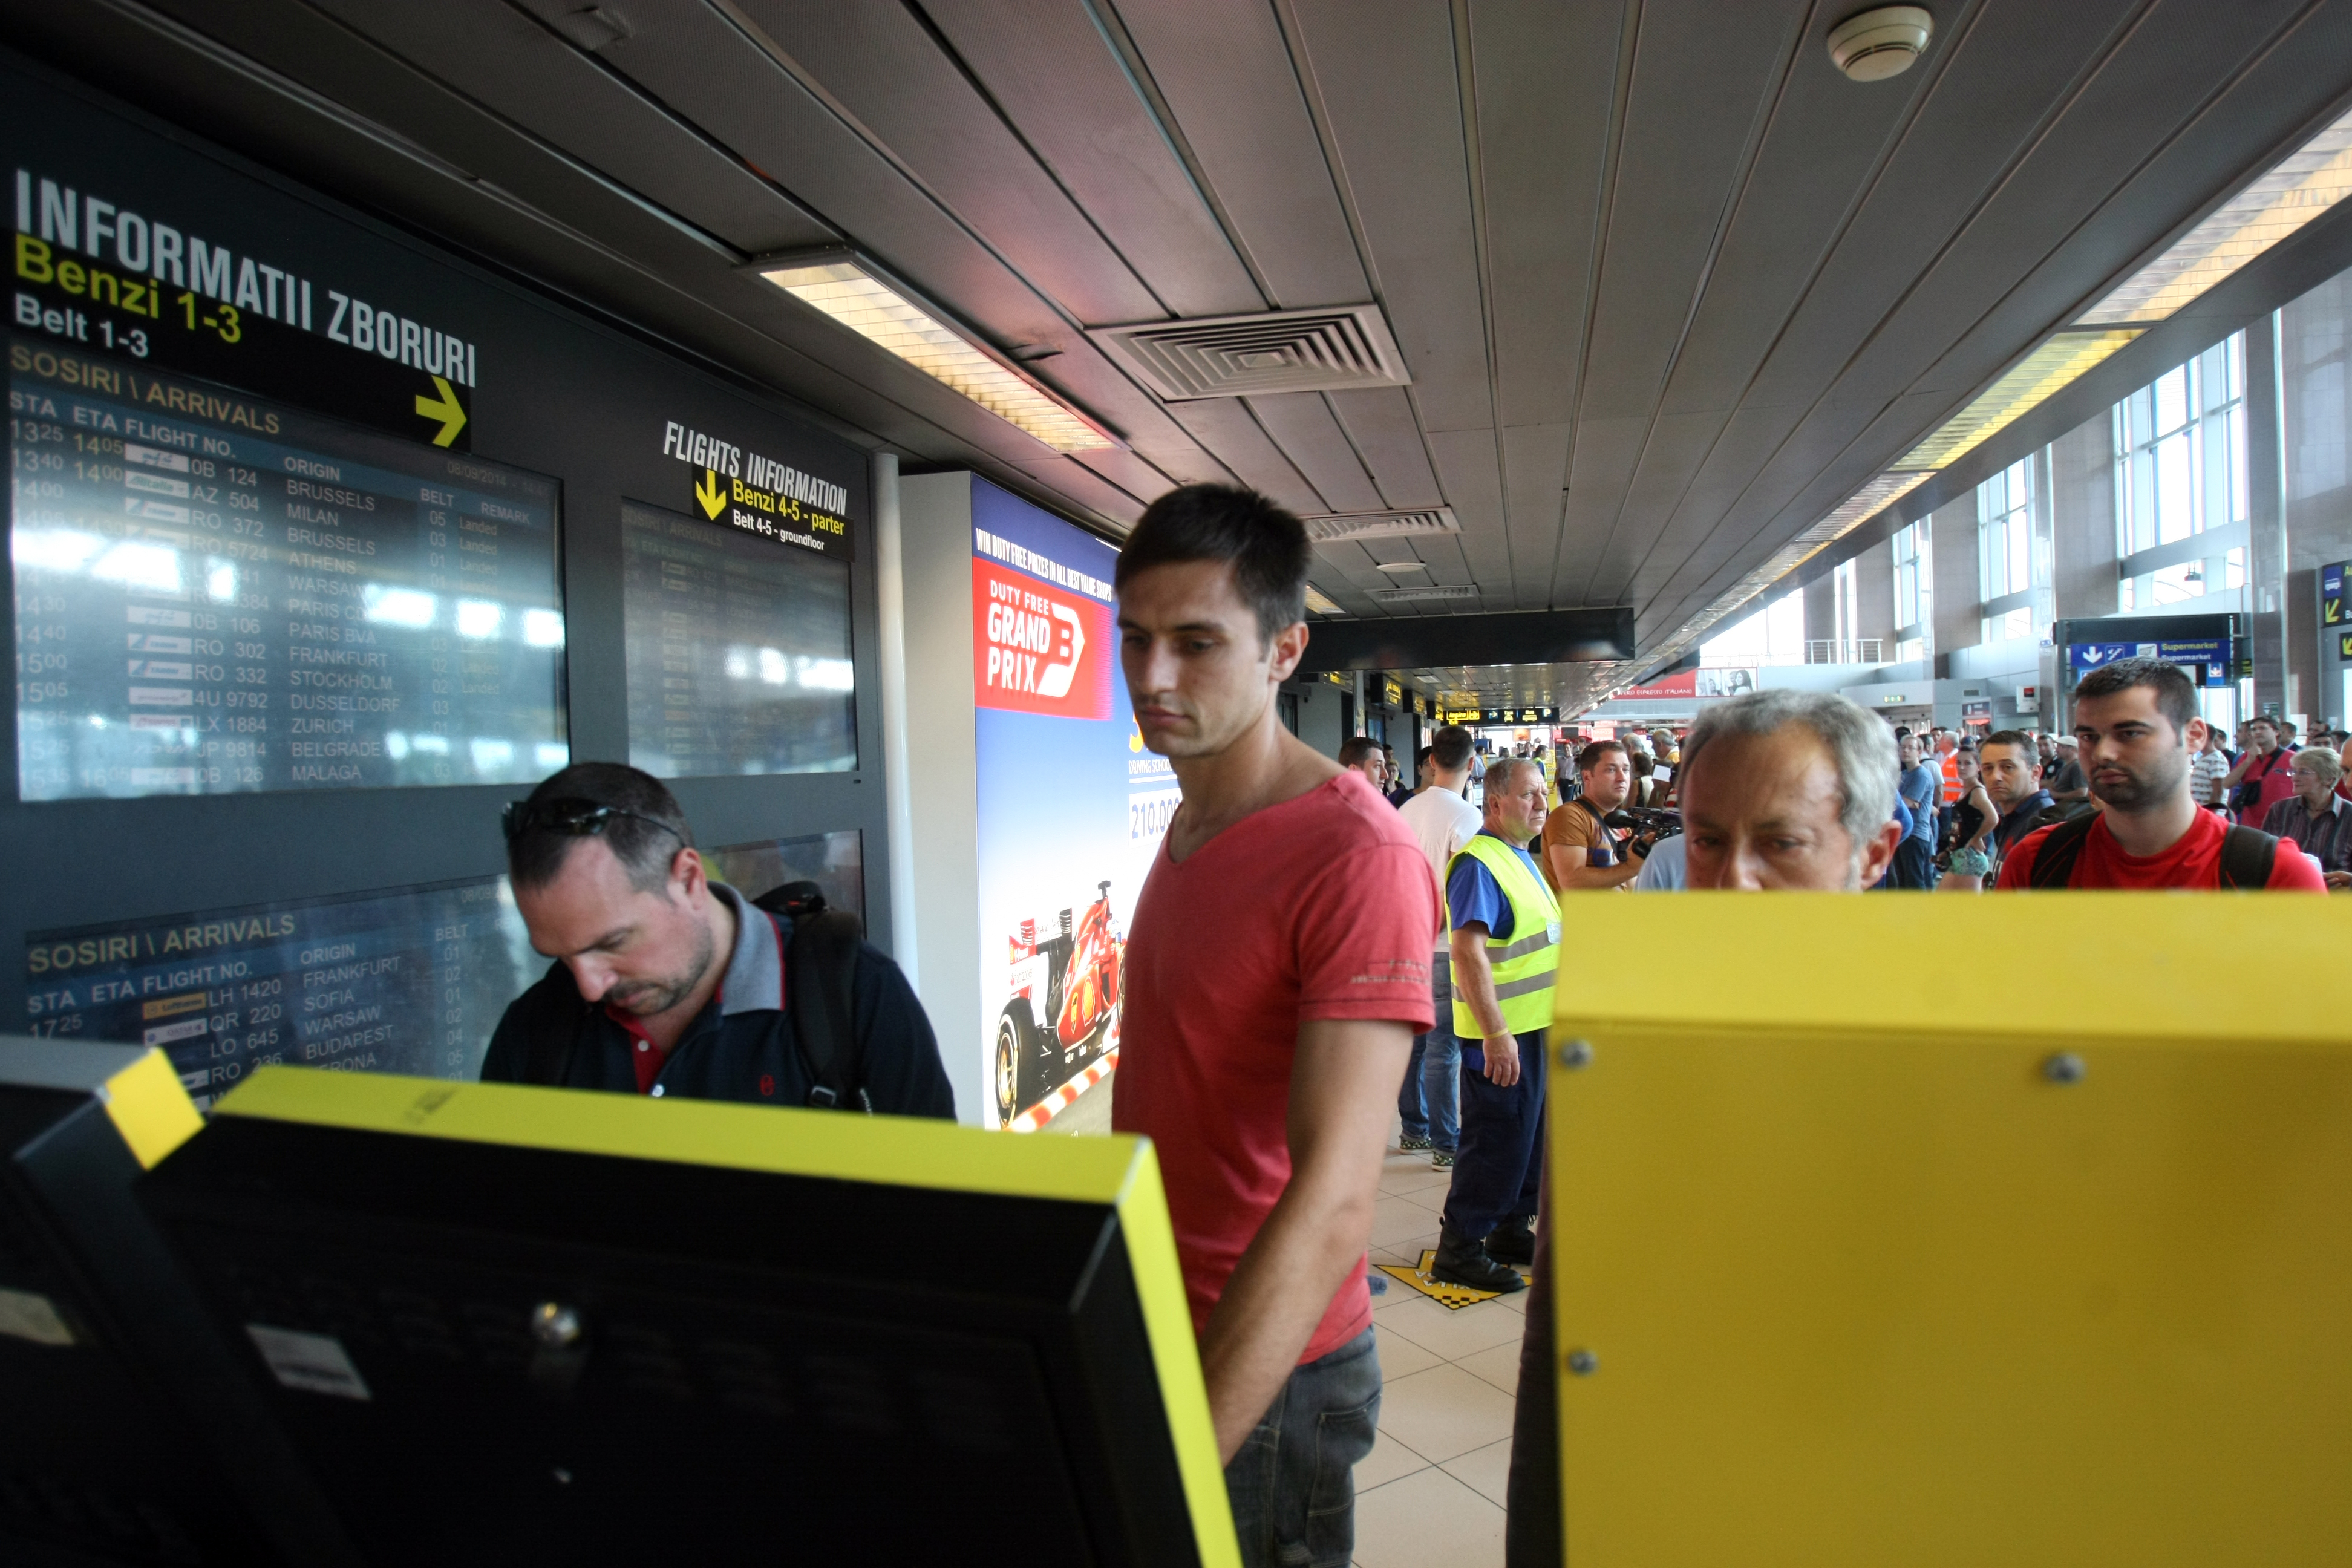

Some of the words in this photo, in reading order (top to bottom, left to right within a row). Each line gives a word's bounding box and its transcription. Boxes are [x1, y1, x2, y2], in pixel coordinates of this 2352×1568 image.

[16, 169, 312, 332] INFORMATII
[328, 290, 475, 388] ZBORURI
[16, 234, 160, 319] Benzi
[177, 292, 241, 343] 1-3
[15, 293, 87, 341] Belt
[99, 322, 149, 357] 1-3
[11, 345, 120, 395] SOSIRI
[146, 383, 280, 434] ARRIVALS
[10, 391, 57, 417] STA
[74, 406, 117, 431] ETA
[126, 419, 197, 449] FLIGHT
[204, 437, 236, 459] NO.
[284, 456, 341, 482] ORIGIN
[420, 488, 454, 508] BELT
[481, 502, 530, 525] REMARK
[664, 421, 740, 478] FLIGHTS
[747, 452, 847, 515] INFORMATION
[192, 486, 218, 505] AZ
[229, 492, 259, 511] 504
[287, 503, 338, 526] MILAN
[430, 531, 446, 547] 03
[459, 537, 497, 556] Landed
[228, 466, 257, 486] 124
[287, 480, 375, 511] BRUSSELS
[430, 510, 446, 526] 05
[459, 516, 497, 536] Landed
[733, 478, 774, 513] Benzi
[778, 498, 799, 521] 4-5
[812, 512, 844, 535] parter
[192, 511, 221, 529] RO
[234, 517, 263, 537] 372
[287, 528, 375, 555] BRUSSELS
[430, 552, 445, 568] 01
[460, 558, 497, 575] Landed
[733, 510, 754, 531] Belt
[756, 518, 772, 535] 4-5
[780, 529, 825, 550] groundfloor
[193, 537, 222, 555] RO
[228, 542, 269, 562] 5724
[289, 552, 356, 575] ATHENS
[430, 573, 445, 589] 01
[976, 528, 991, 555] WIN
[992, 534, 1010, 563] DUTY
[1011, 543, 1027, 570] FREE
[1028, 550, 1048, 579] PRIZES
[1049, 560, 1056, 582] IN
[1056, 563, 1067, 586] ALL
[1067, 567, 1080, 590] BEST
[1080, 573, 1096, 596] VALUE
[1096, 579, 1112, 603] SHOPS
[289, 599, 339, 619] PARIS
[990, 580, 1021, 606] DUTY
[1025, 592, 1049, 616] FREE
[231, 618, 260, 634] 106
[289, 622, 339, 641] PARIS
[345, 628, 376, 644] BVA
[988, 602, 1050, 654] GRAND
[2161, 642, 2218, 652] Supermarket
[194, 639, 224, 656] RO
[236, 642, 266, 659] 302
[290, 647, 388, 667] FRANKFURT
[432, 659, 448, 674] 02
[195, 665, 224, 681] RO
[236, 667, 266, 684] 332
[290, 671, 393, 690] STOCKHOLM
[433, 680, 448, 694] 02
[462, 682, 500, 695] Landed
[987, 646, 1037, 693] PRIX
[2161, 653, 2212, 661] Supermarket
[195, 691, 220, 707] 4U
[227, 693, 267, 708] 9792
[291, 694, 400, 712] DUSSELDORF
[433, 701, 449, 715] 03
[197, 716, 220, 731] LX
[292, 718, 353, 734] ZURICH
[197, 742, 220, 758] JP
[292, 742, 380, 757] BELGRADE
[235, 767, 263, 782] 126
[293, 764, 361, 780] MALAGA
[1129, 760, 1151, 774] DRIVING
[28, 990, 76, 1014] STA
[92, 981, 136, 1003] ETA
[143, 966, 215, 994] FLIGHT
[221, 961, 252, 980] NO.
[301, 943, 356, 966] ORIGIN
[436, 924, 468, 942] BELT
[29, 935, 137, 973] SOSIRI
[163, 915, 295, 954] ARRIVALS
[209, 987, 234, 1007] LH
[241, 980, 281, 1001] 1420
[304, 956, 400, 988] FRANKFURT
[444, 946, 460, 961] 01
[211, 1012, 239, 1032] QR
[250, 1004, 281, 1024] 220
[304, 989, 354, 1013] SOFIA
[445, 966, 460, 982] 02
[211, 1039, 236, 1058] LO
[247, 1029, 278, 1049] 645
[304, 1005, 381, 1036] WARSAW
[445, 987, 460, 1004] 01
[211, 1063, 240, 1084] RO
[306, 1025, 394, 1060] BUDAPEST
[446, 1008, 462, 1024] 02
[446, 1029, 463, 1045] 04
[447, 1051, 463, 1066] 05
